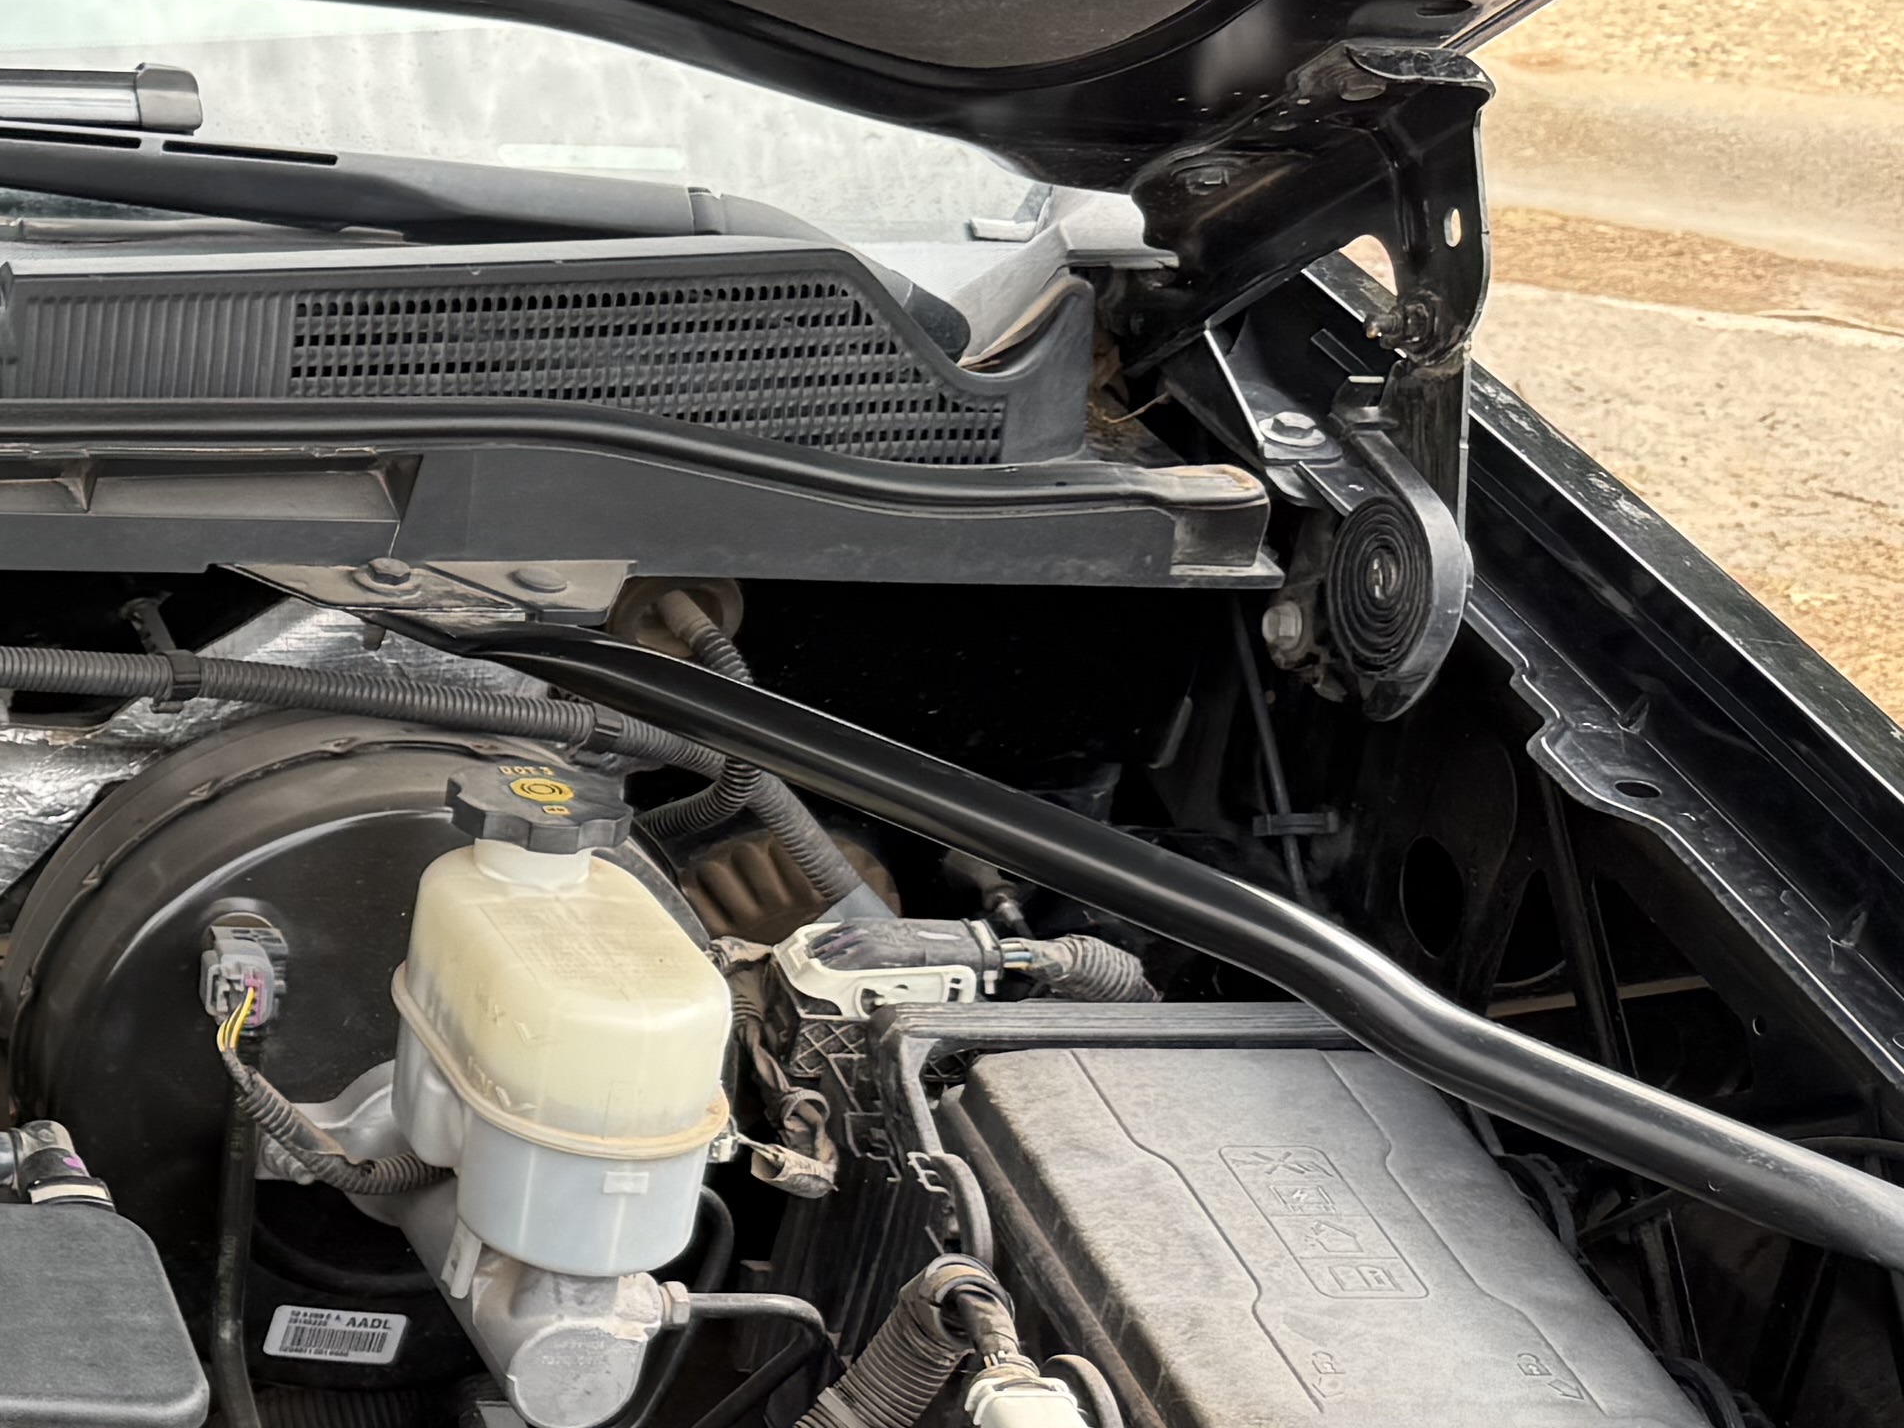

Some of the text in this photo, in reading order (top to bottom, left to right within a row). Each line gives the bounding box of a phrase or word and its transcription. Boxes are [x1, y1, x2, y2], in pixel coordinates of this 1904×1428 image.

[498, 766, 555, 776] DOT 3
[346, 1317, 392, 1330] AADL
